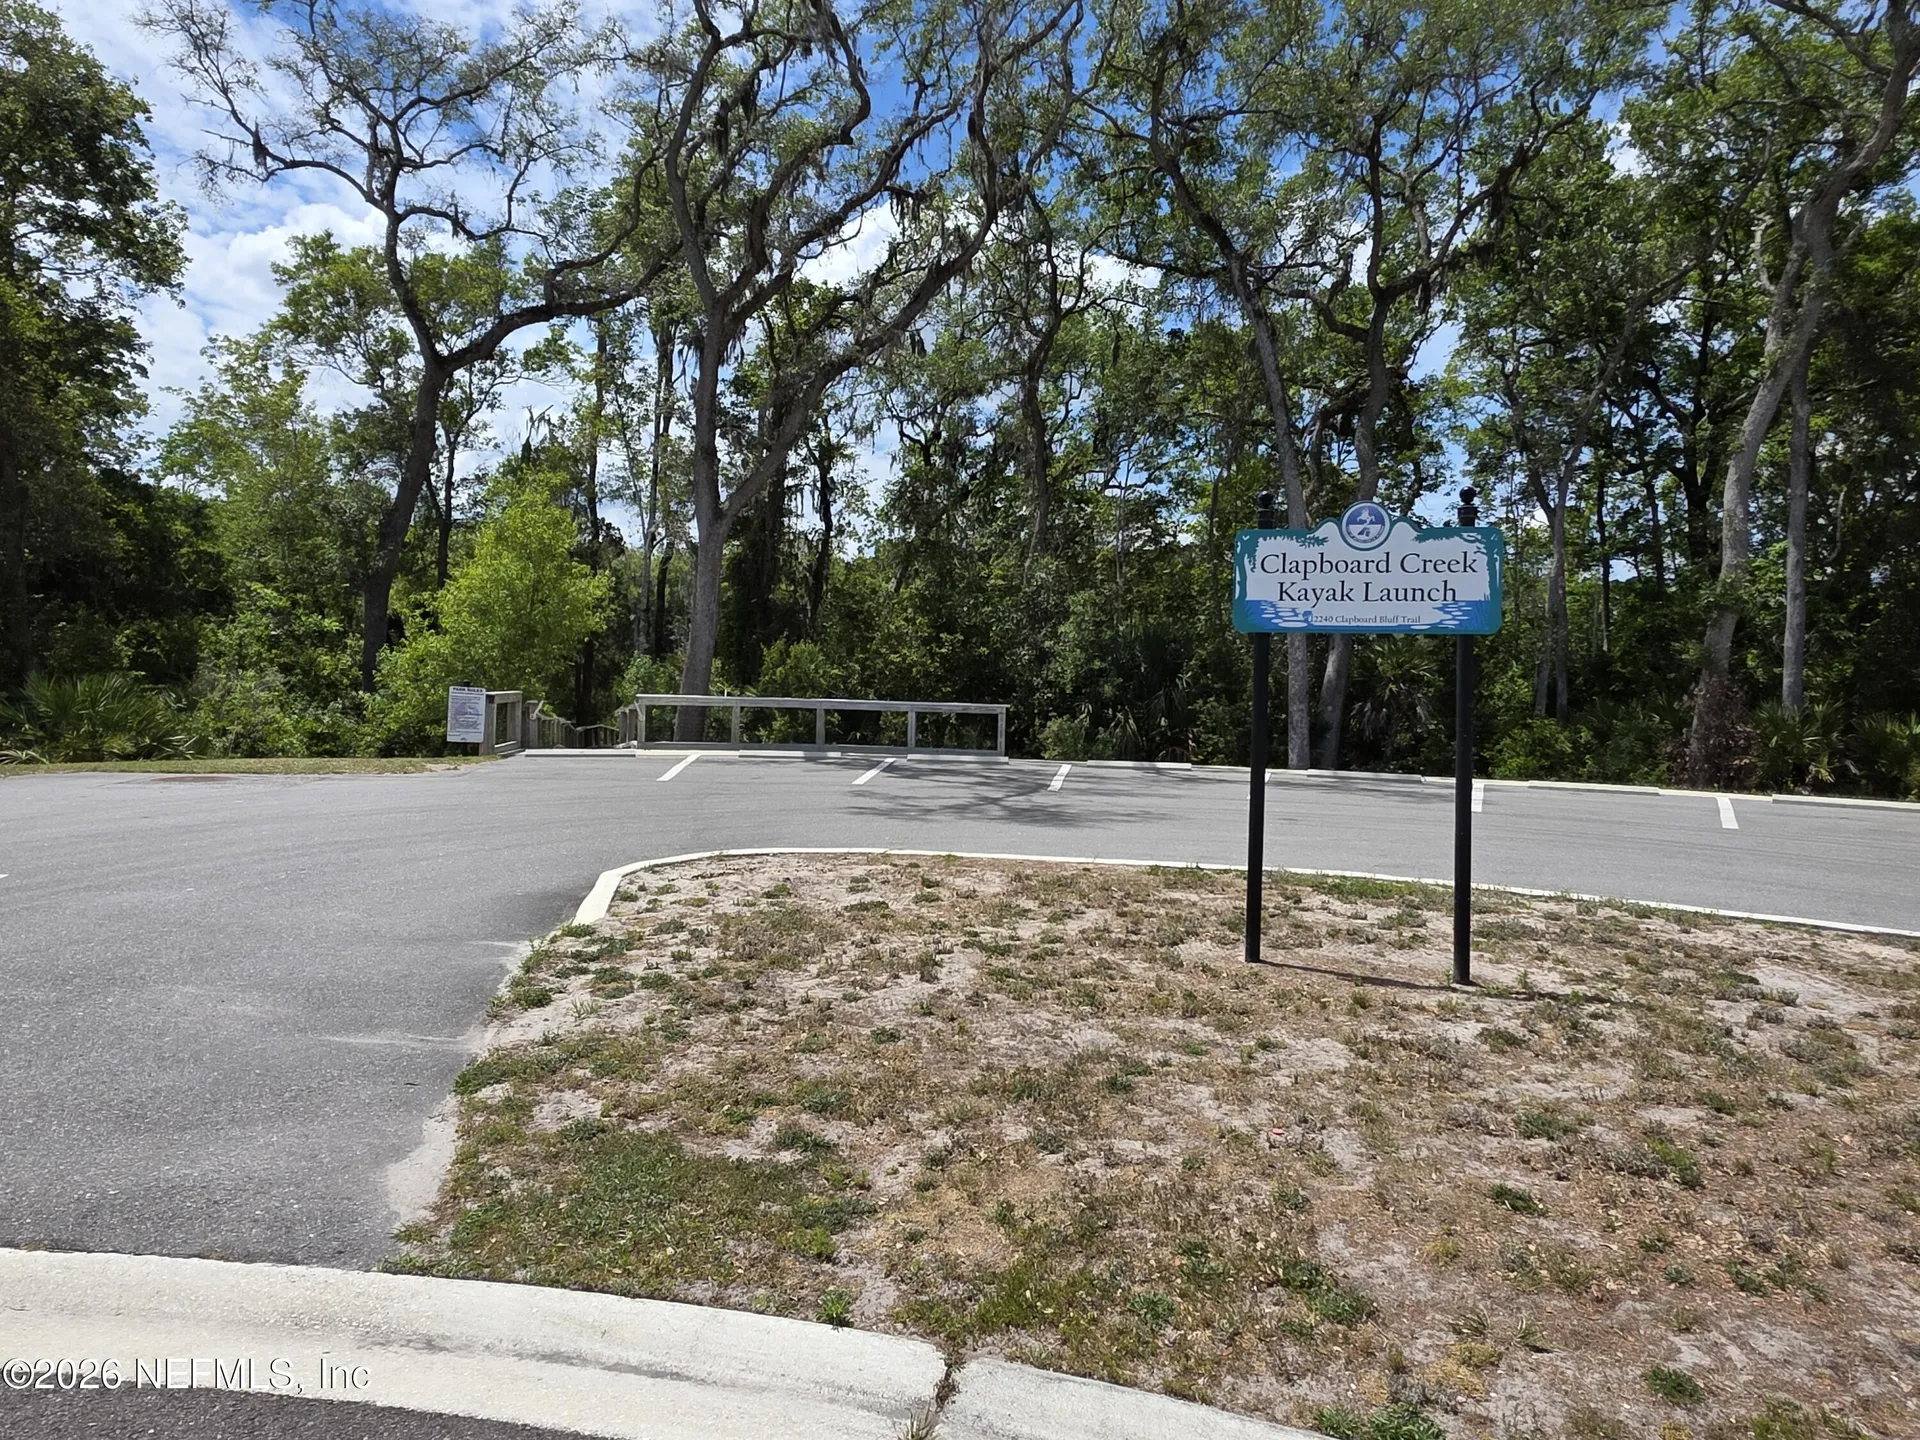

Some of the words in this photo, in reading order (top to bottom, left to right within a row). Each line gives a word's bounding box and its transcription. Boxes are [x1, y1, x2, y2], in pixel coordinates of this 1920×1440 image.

[1260, 552, 1391, 580] Clapboard
[1400, 551, 1478, 573] Creek
[1278, 580, 1355, 608] Kayak
[1363, 580, 1457, 602] Launch
[1335, 615, 1377, 625] Clapboard
[1379, 615, 1400, 624] Bluff
[1402, 615, 1421, 624] Trail
